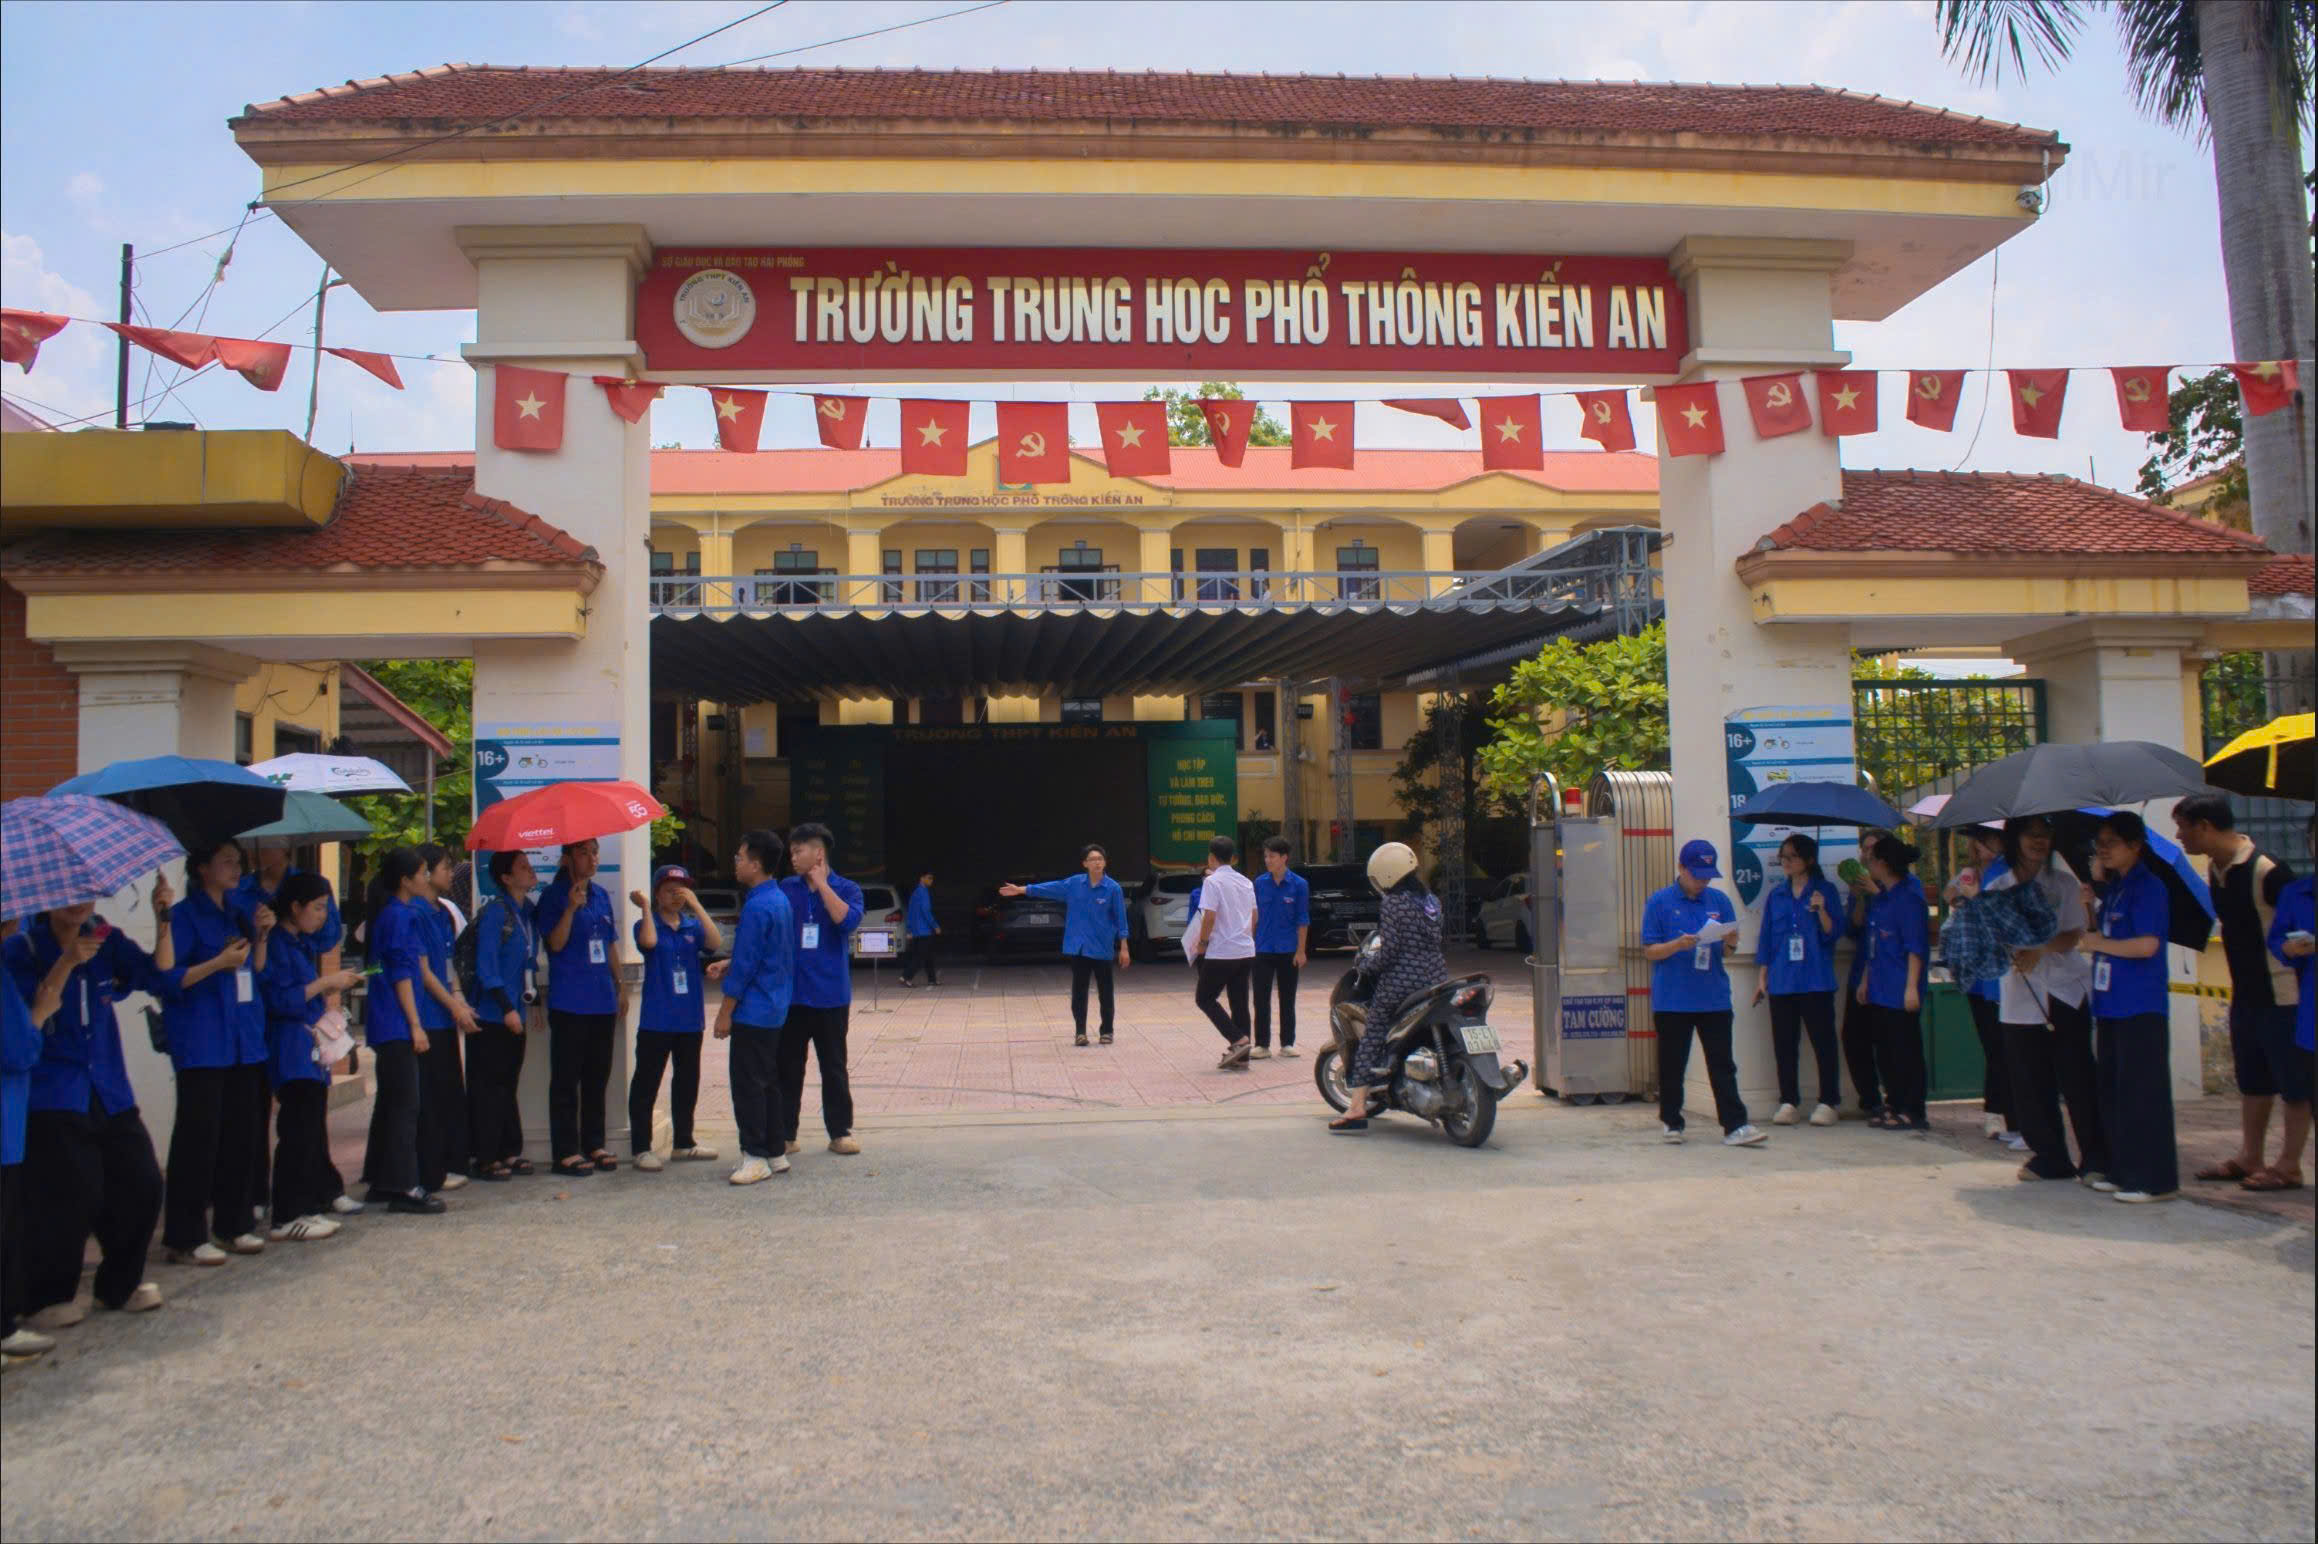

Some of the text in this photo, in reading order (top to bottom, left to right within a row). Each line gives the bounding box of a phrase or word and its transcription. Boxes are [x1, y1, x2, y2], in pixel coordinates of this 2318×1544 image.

[790, 261, 973, 343] TRƯỜNG
[987, 275, 1131, 343] TRUNG
[1245, 252, 1331, 345] PHỔ
[1342, 266, 1484, 347] THÔNG
[1496, 261, 1594, 348] KIẾN
[1608, 286, 1668, 349] AN
[1124, 495, 1144, 505] AN
[992, 727, 1041, 740] THPT
[1105, 726, 1137, 738] AN
[1727, 733, 1753, 749] 16+
[476, 750, 505, 767] 16+
[518, 827, 555, 838] viettel
[1735, 868, 1761, 884] 21+
